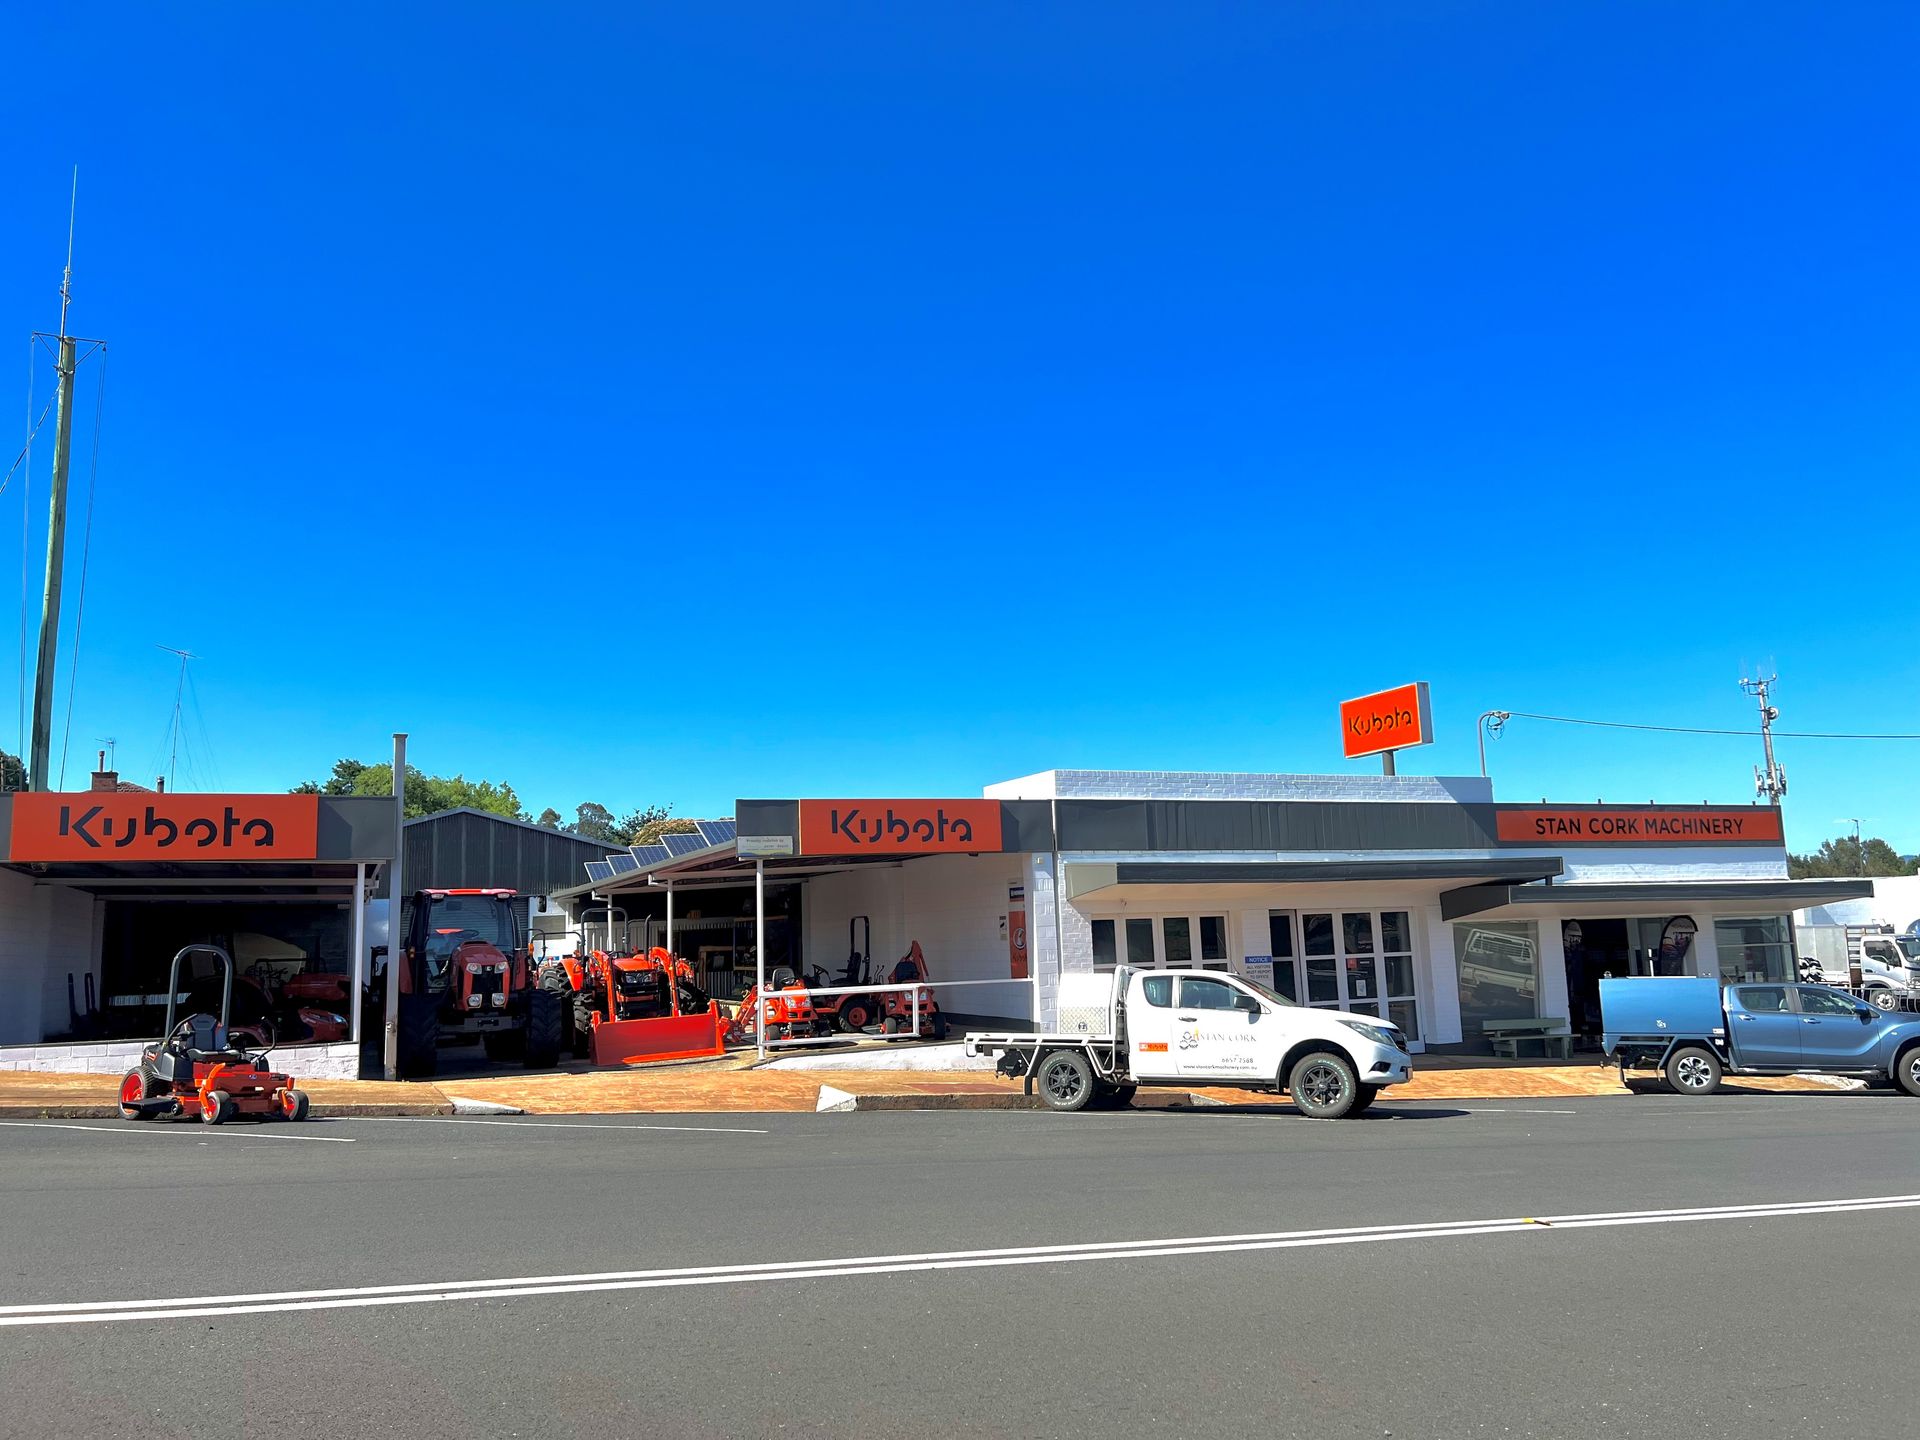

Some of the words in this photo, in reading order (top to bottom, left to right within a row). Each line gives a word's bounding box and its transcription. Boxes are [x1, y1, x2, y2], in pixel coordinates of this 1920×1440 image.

[1349, 706, 1411, 735] Kubota
[59, 806, 274, 847] Kubota
[831, 809, 972, 843] Kubota
[1535, 818, 1581, 835] STAN
[1589, 817, 1640, 835] CORK
[1644, 817, 1744, 835] MACHINERY
[1200, 1033, 1225, 1041] STAN
[1228, 1034, 1257, 1042] CORK
